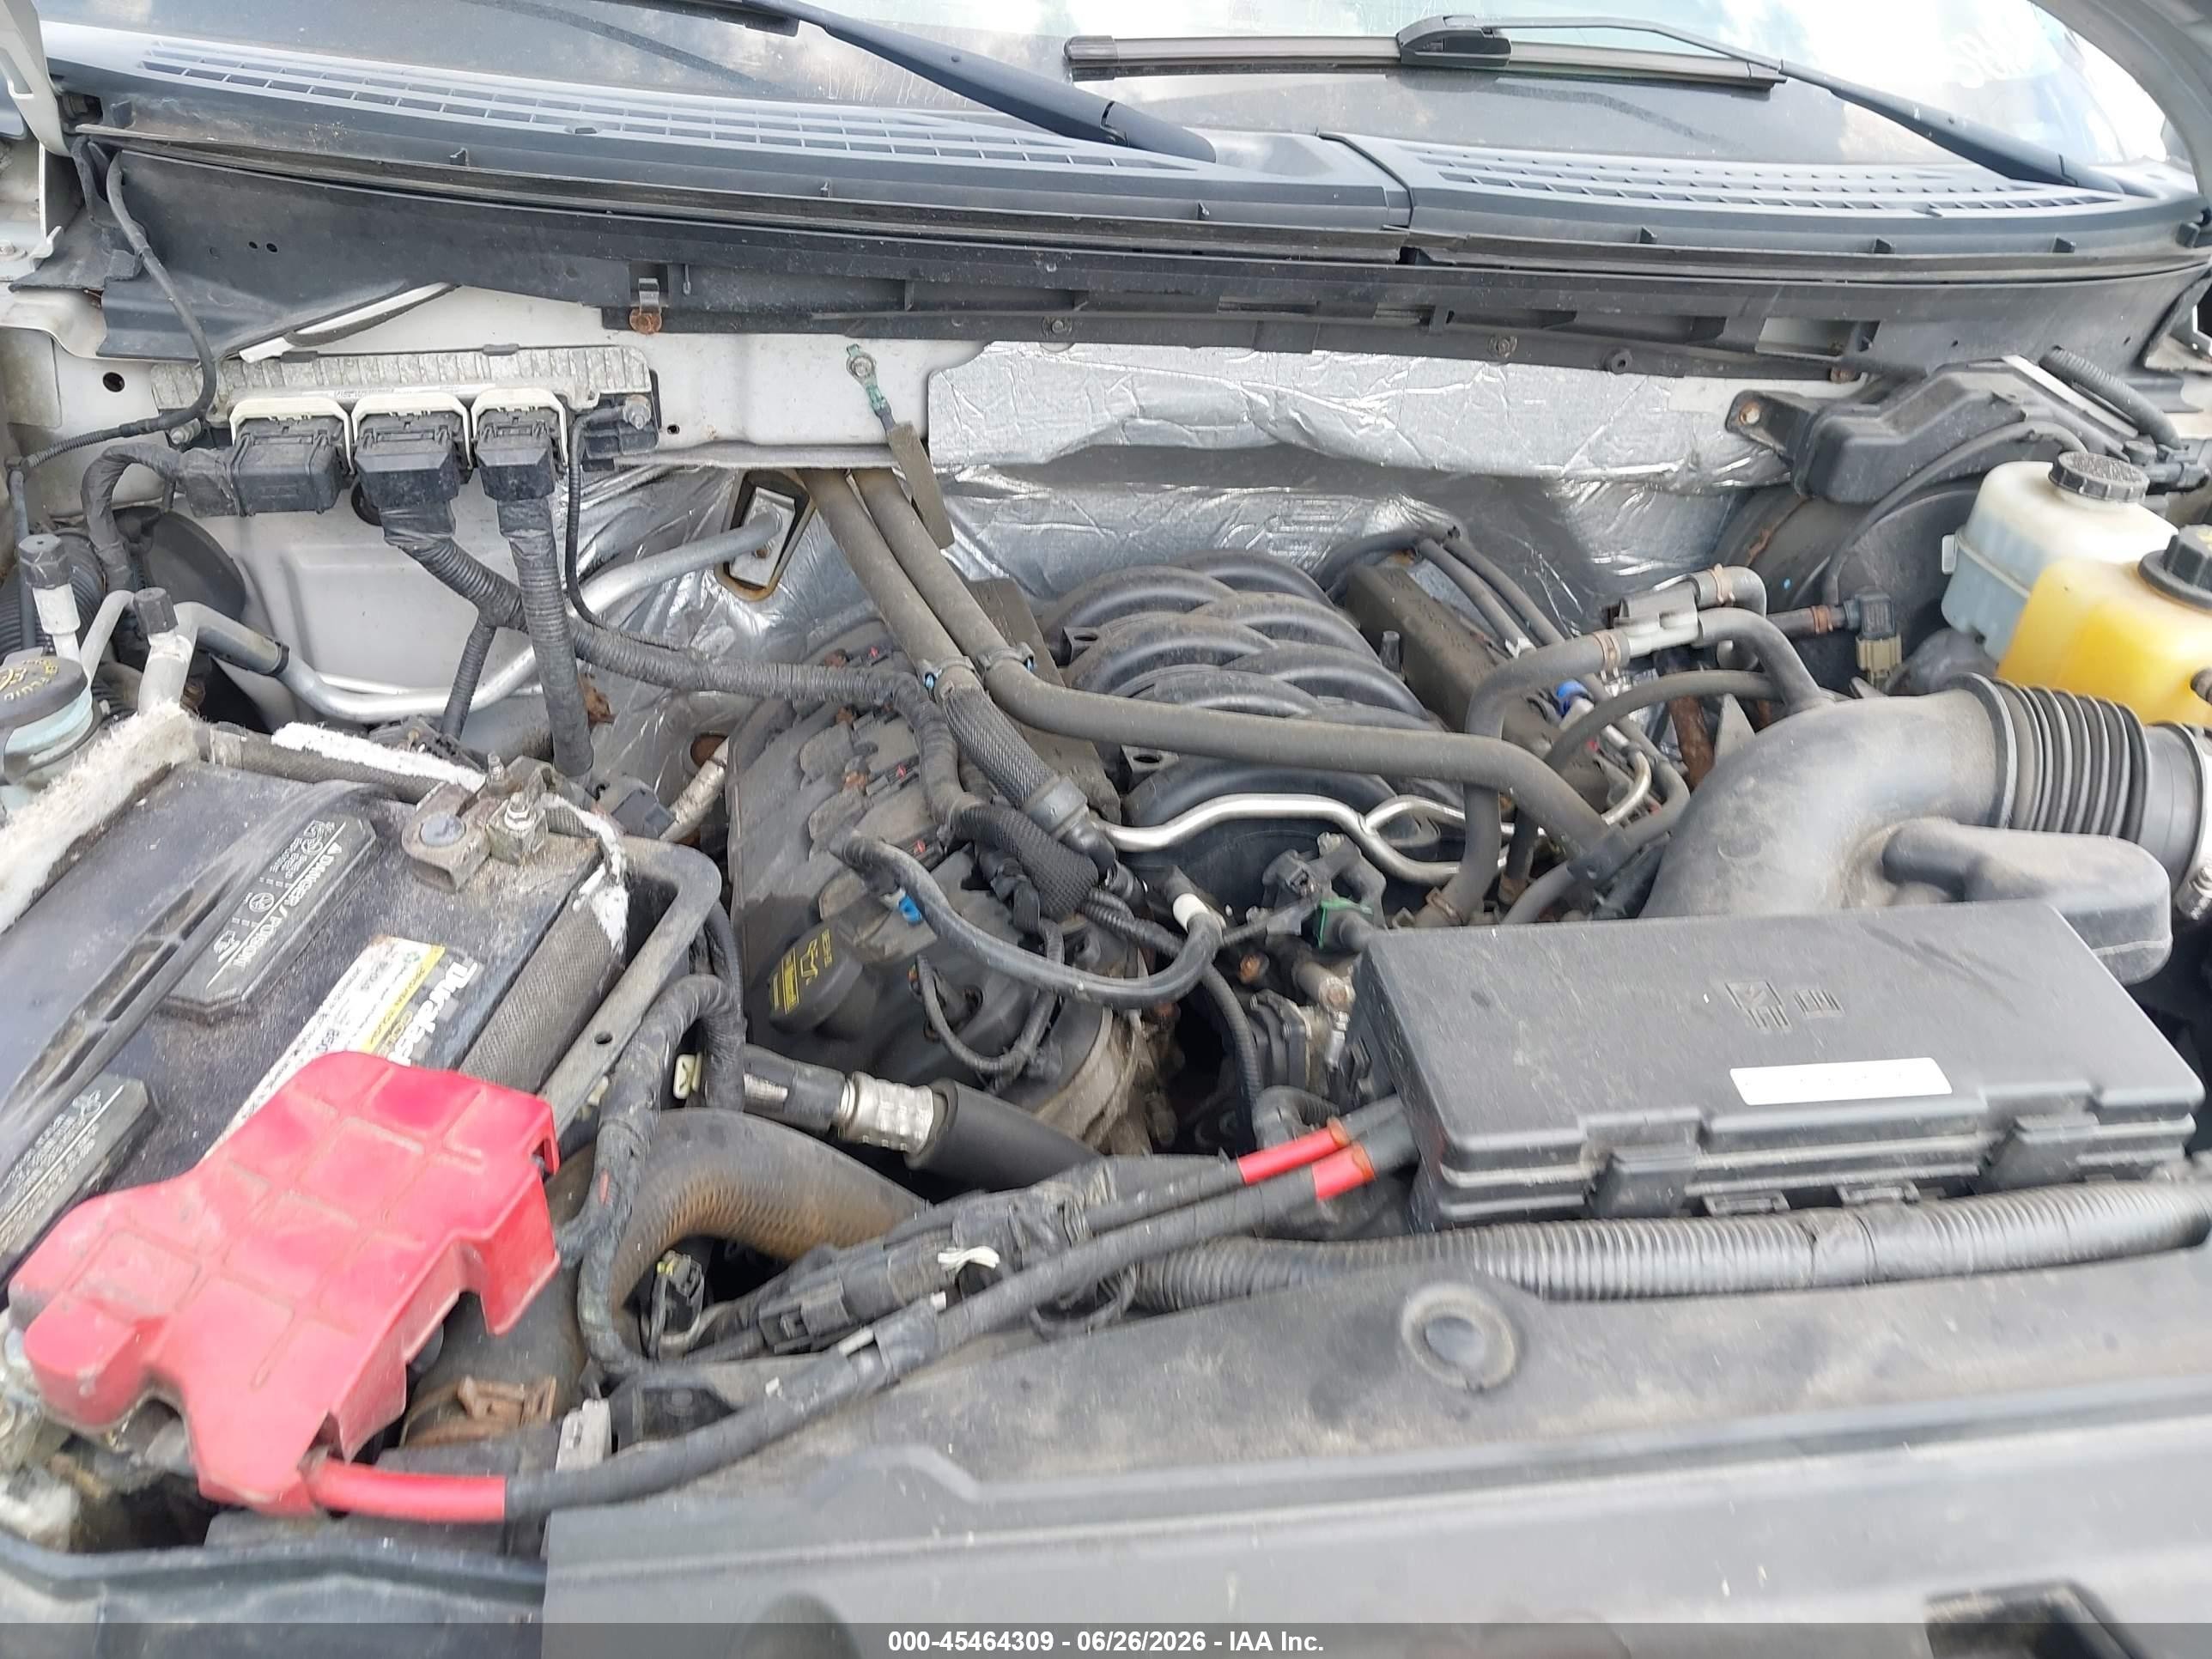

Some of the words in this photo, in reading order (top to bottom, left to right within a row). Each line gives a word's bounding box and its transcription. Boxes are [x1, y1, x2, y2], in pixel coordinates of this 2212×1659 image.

[283, 854, 334, 908] DANGER
[233, 915, 283, 969] POISON
[388, 961, 478, 1067] Duralast
